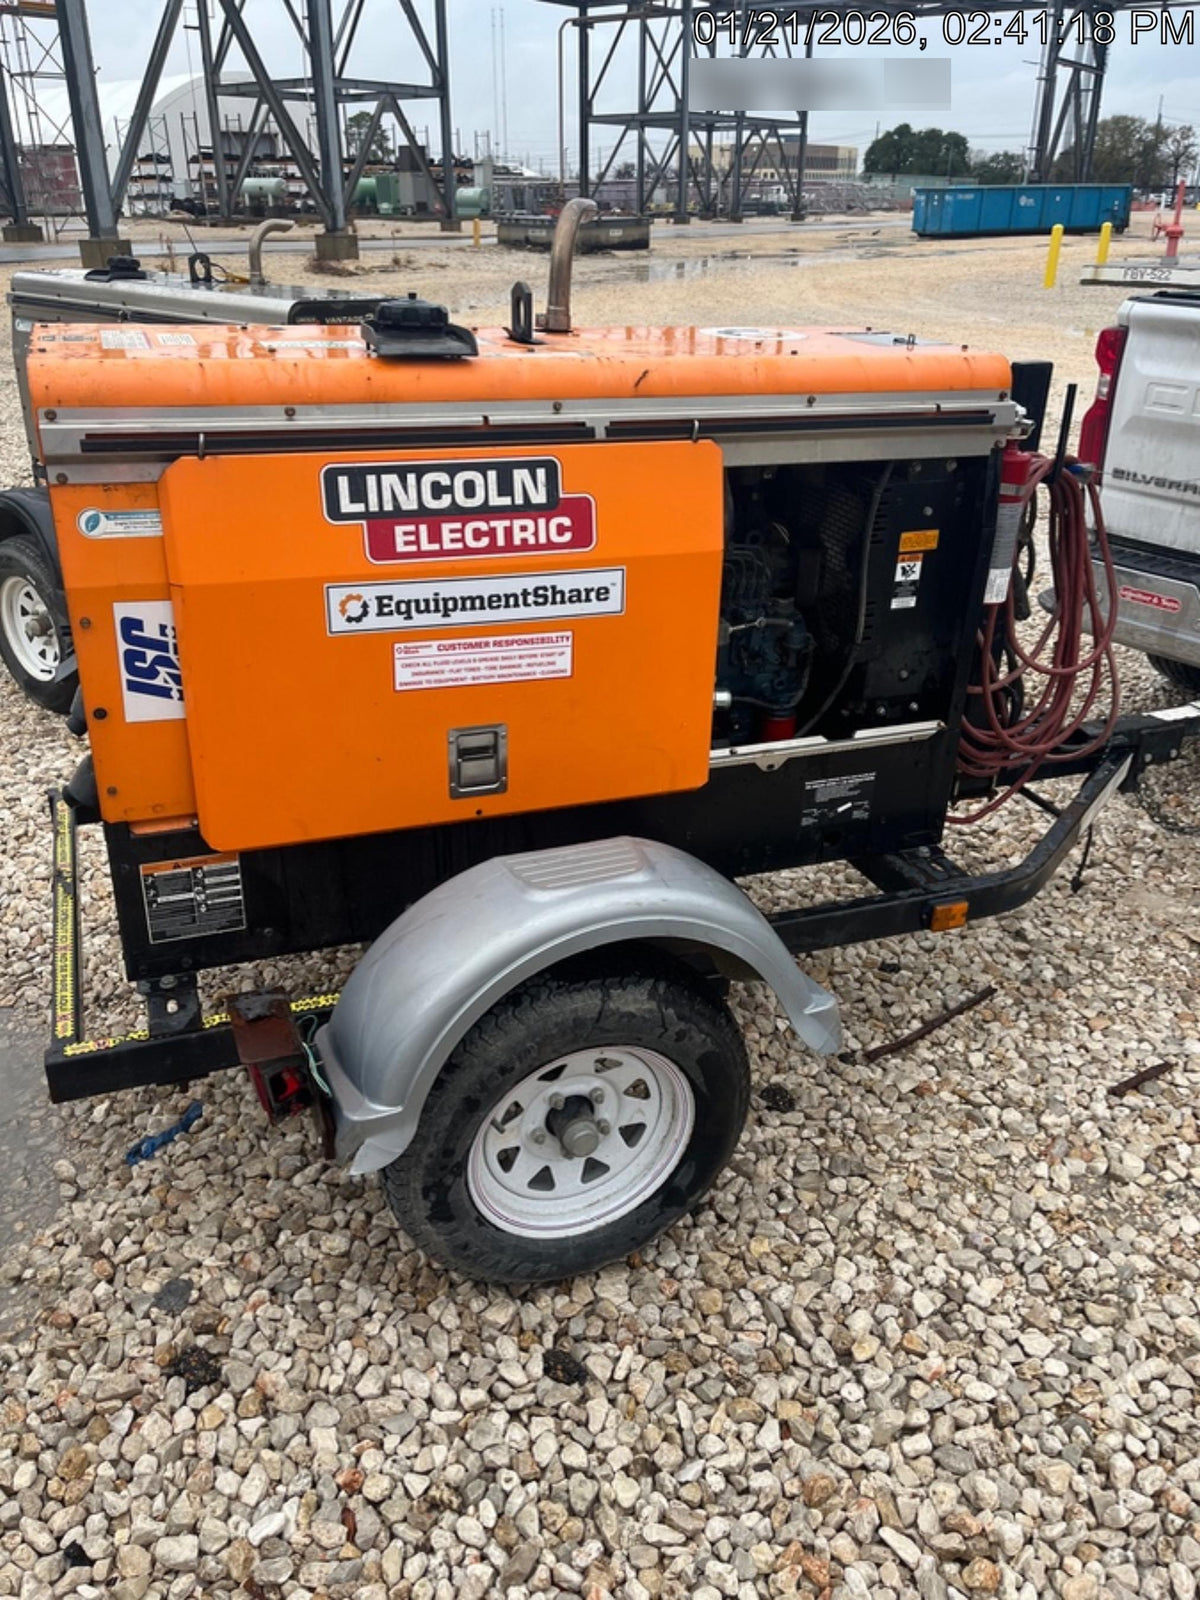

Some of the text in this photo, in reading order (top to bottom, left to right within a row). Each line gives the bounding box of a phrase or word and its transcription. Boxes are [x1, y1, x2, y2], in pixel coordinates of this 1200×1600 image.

[337, 467, 548, 513] LINCOLN
[1111, 467, 1200, 496] SILVERA
[394, 516, 573, 553] ELECTRIC
[437, 635, 570, 652] CUSTOMER RESPONSIBILITY
